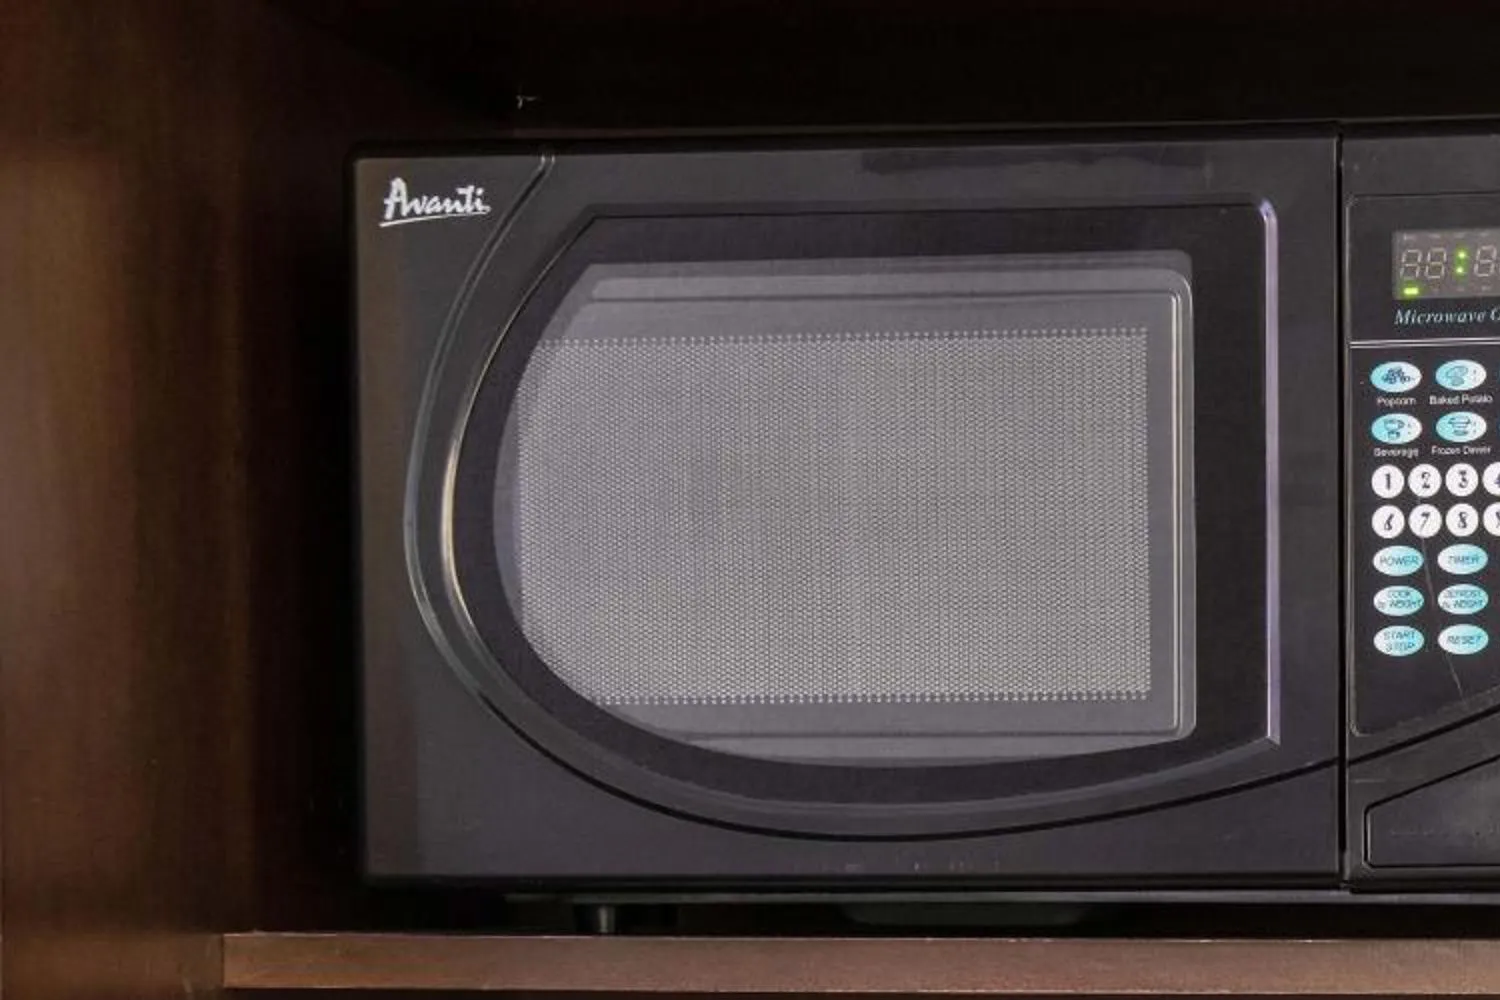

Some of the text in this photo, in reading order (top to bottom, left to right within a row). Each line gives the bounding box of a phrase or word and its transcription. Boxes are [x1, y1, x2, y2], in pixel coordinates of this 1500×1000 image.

[379, 177, 491, 227] Avanti
[1394, 308, 1485, 325] Microwave
[1379, 554, 1419, 566] POWER
[1448, 555, 1480, 564] TIMER
[1383, 631, 1415, 640] START
[1447, 635, 1482, 645] RESET
